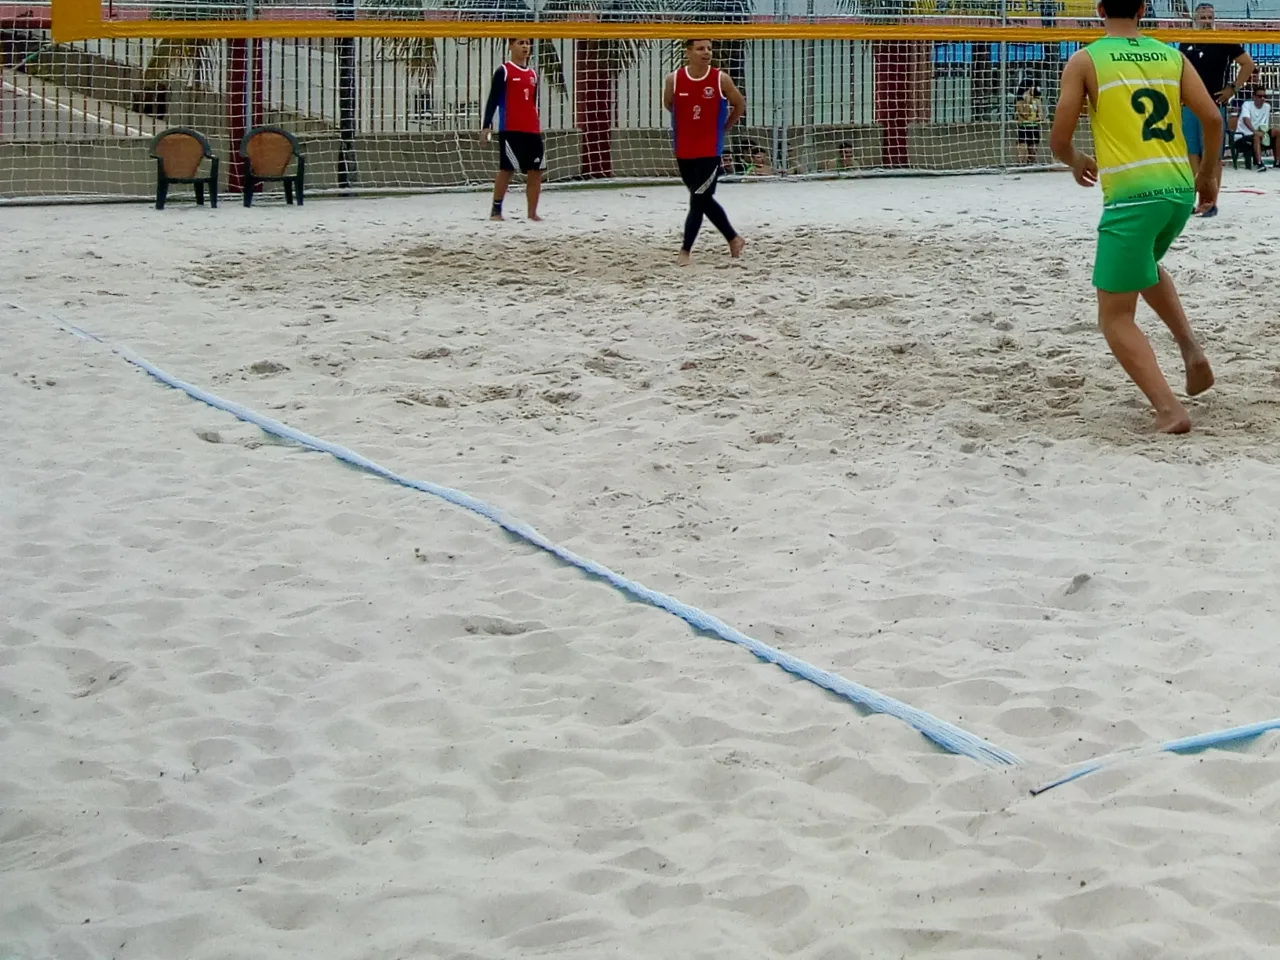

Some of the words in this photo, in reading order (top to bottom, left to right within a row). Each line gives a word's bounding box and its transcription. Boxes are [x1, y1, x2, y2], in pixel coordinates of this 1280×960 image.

[1109, 52, 1168, 62] LAEDSON
[523, 88, 530, 101] 1
[692, 104, 702, 120] 2
[1131, 87, 1175, 143] 2
